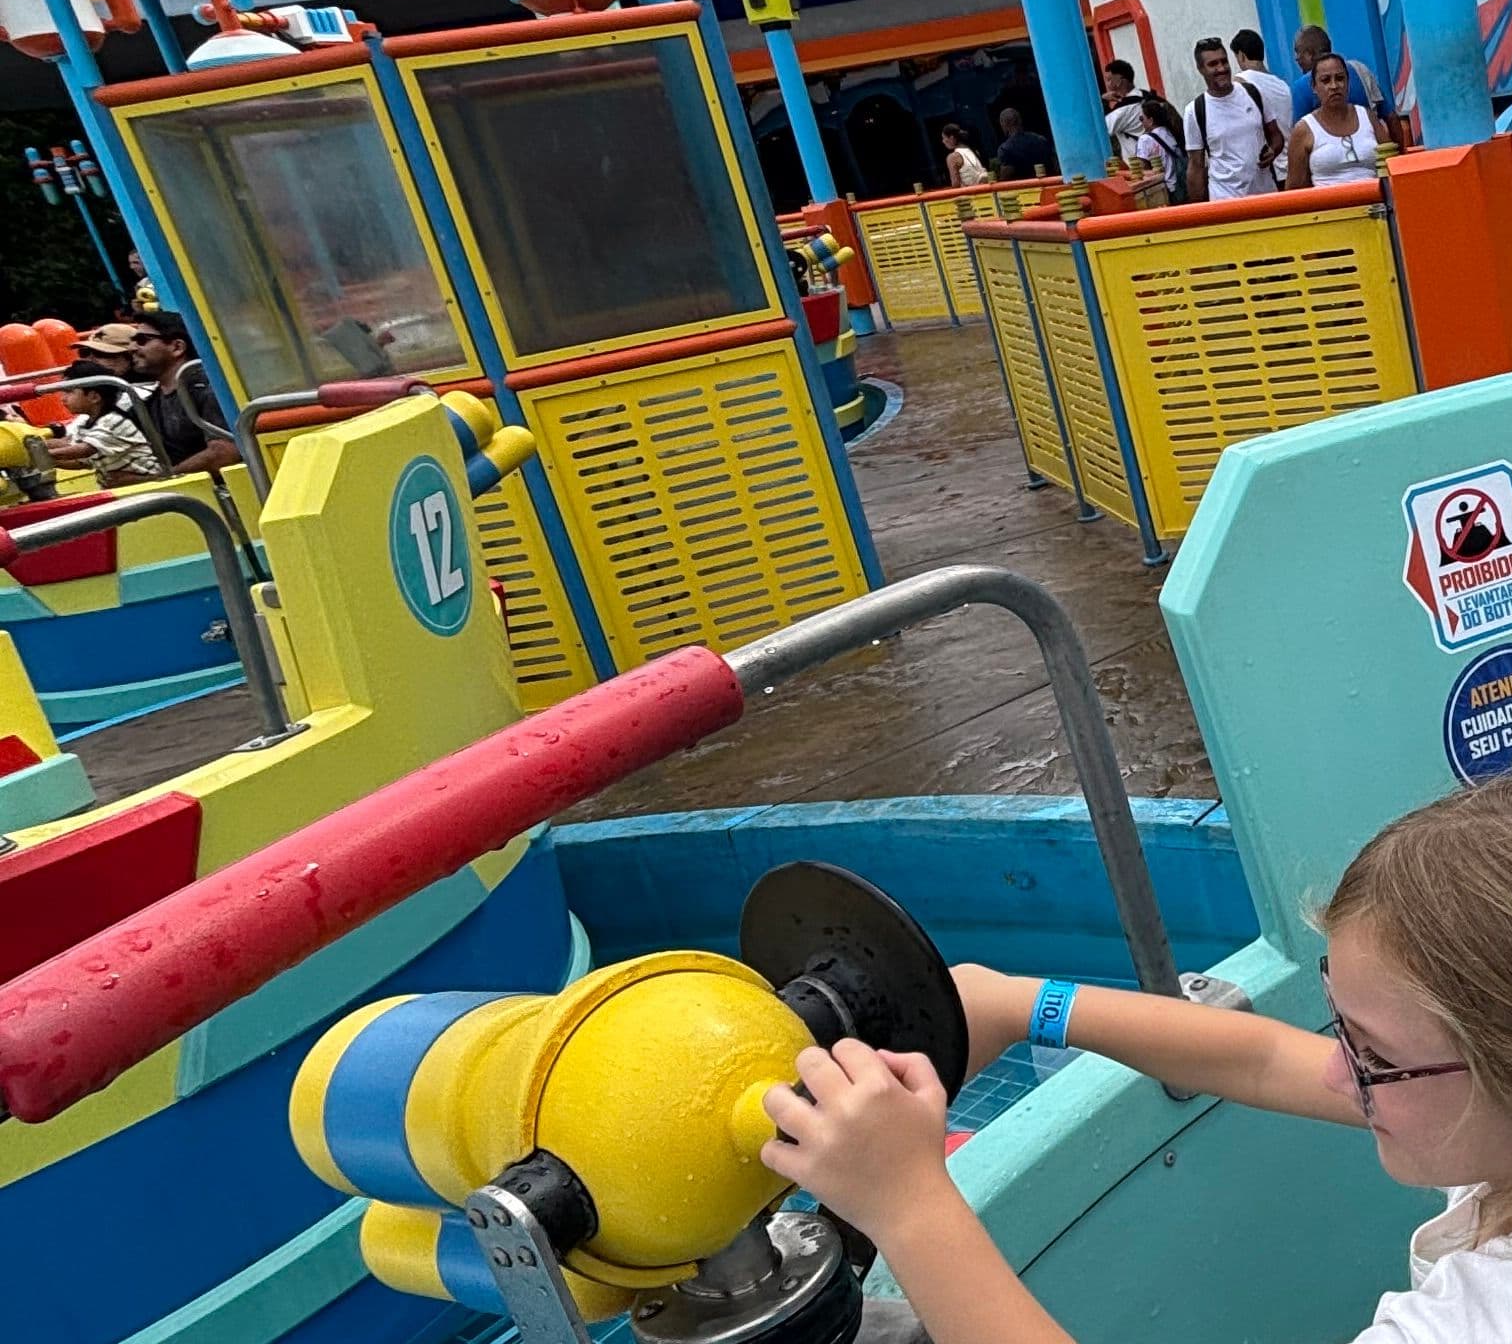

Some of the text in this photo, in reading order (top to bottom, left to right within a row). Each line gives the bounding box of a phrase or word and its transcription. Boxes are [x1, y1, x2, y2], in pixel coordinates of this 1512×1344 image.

[410, 491, 465, 605] 12
[1461, 611, 1481, 630] DO
[1469, 732, 1500, 760] SEU
[1042, 993, 1063, 1019] 110
